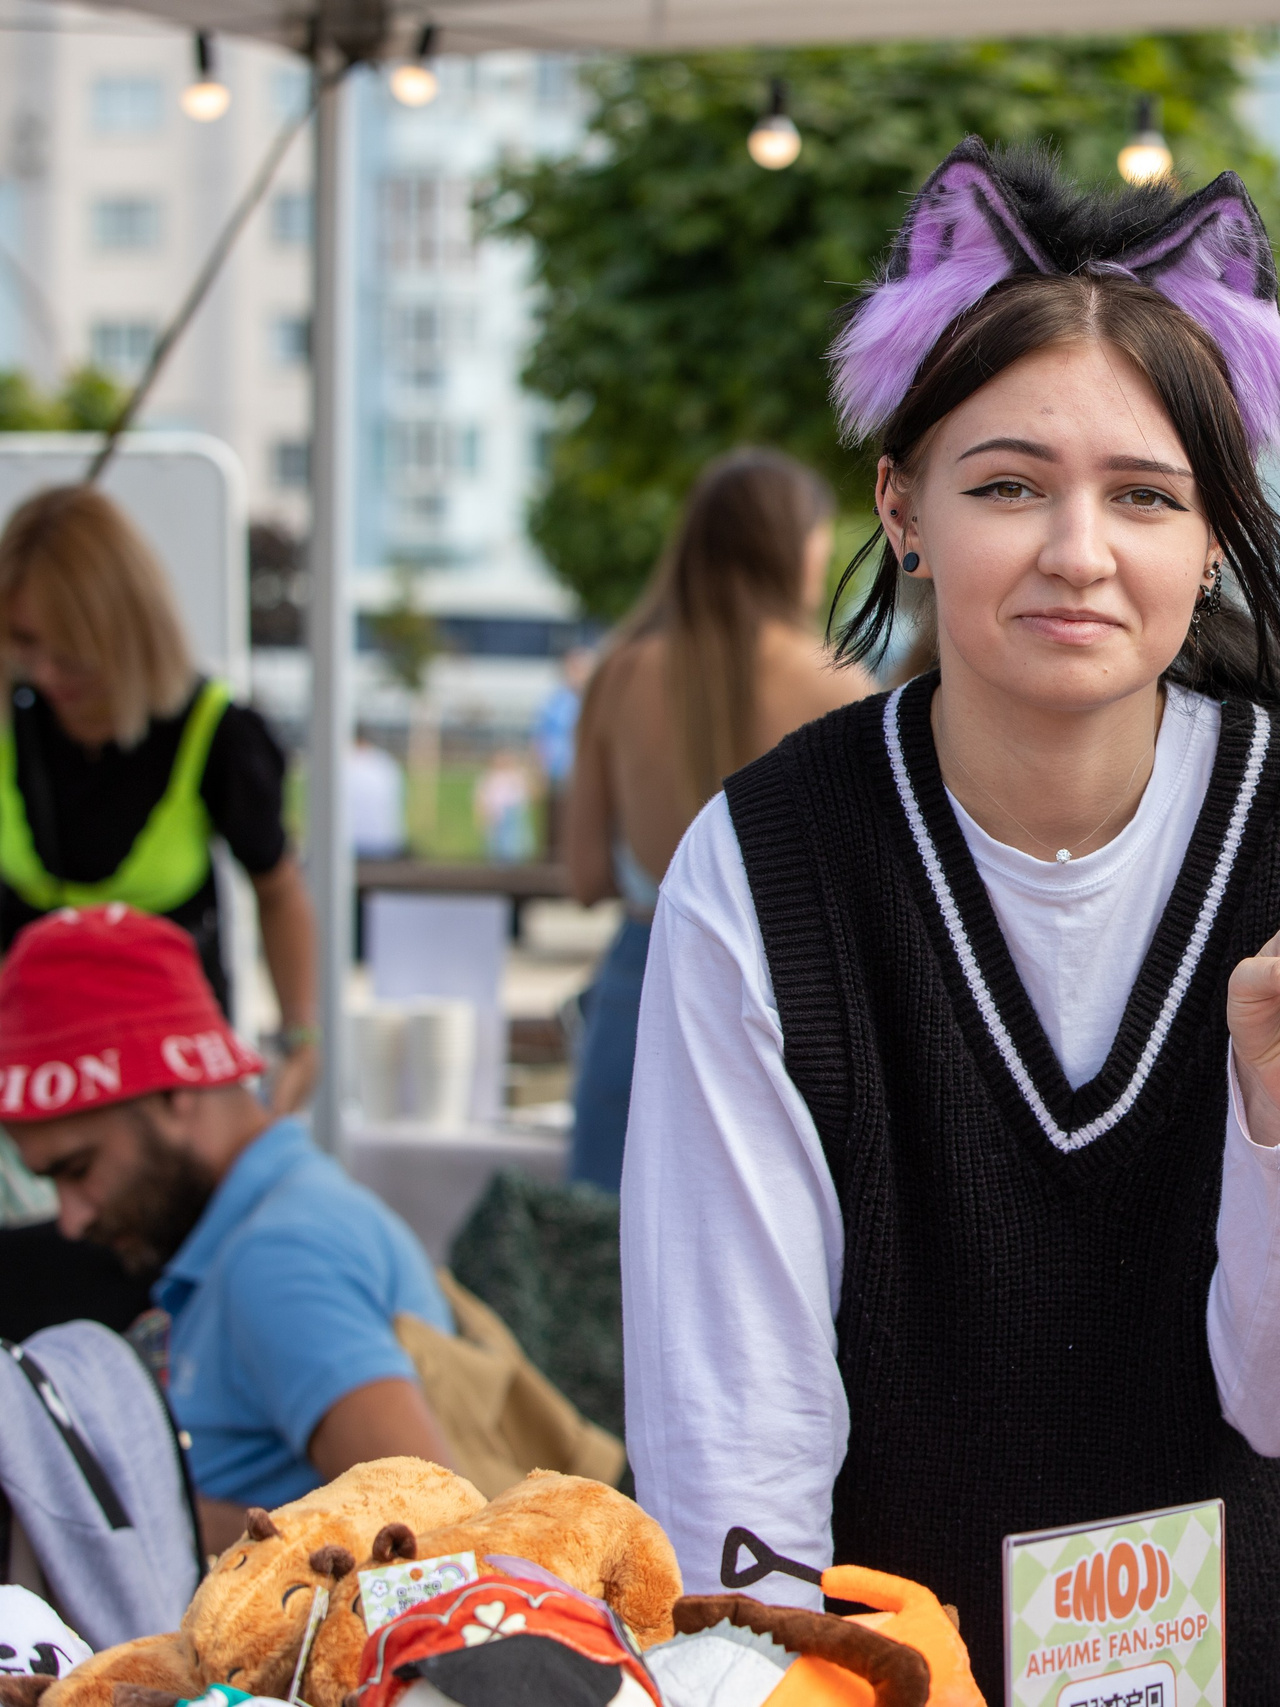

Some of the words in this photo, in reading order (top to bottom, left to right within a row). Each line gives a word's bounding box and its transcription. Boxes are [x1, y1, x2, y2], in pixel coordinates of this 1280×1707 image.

[0, 1048, 121, 1112] ION
[1055, 1542, 1170, 1622] EMOJI
[1027, 1638, 1101, 1678] АНИМЕ
[1109, 1614, 1208, 1658] FAN.SHOP
